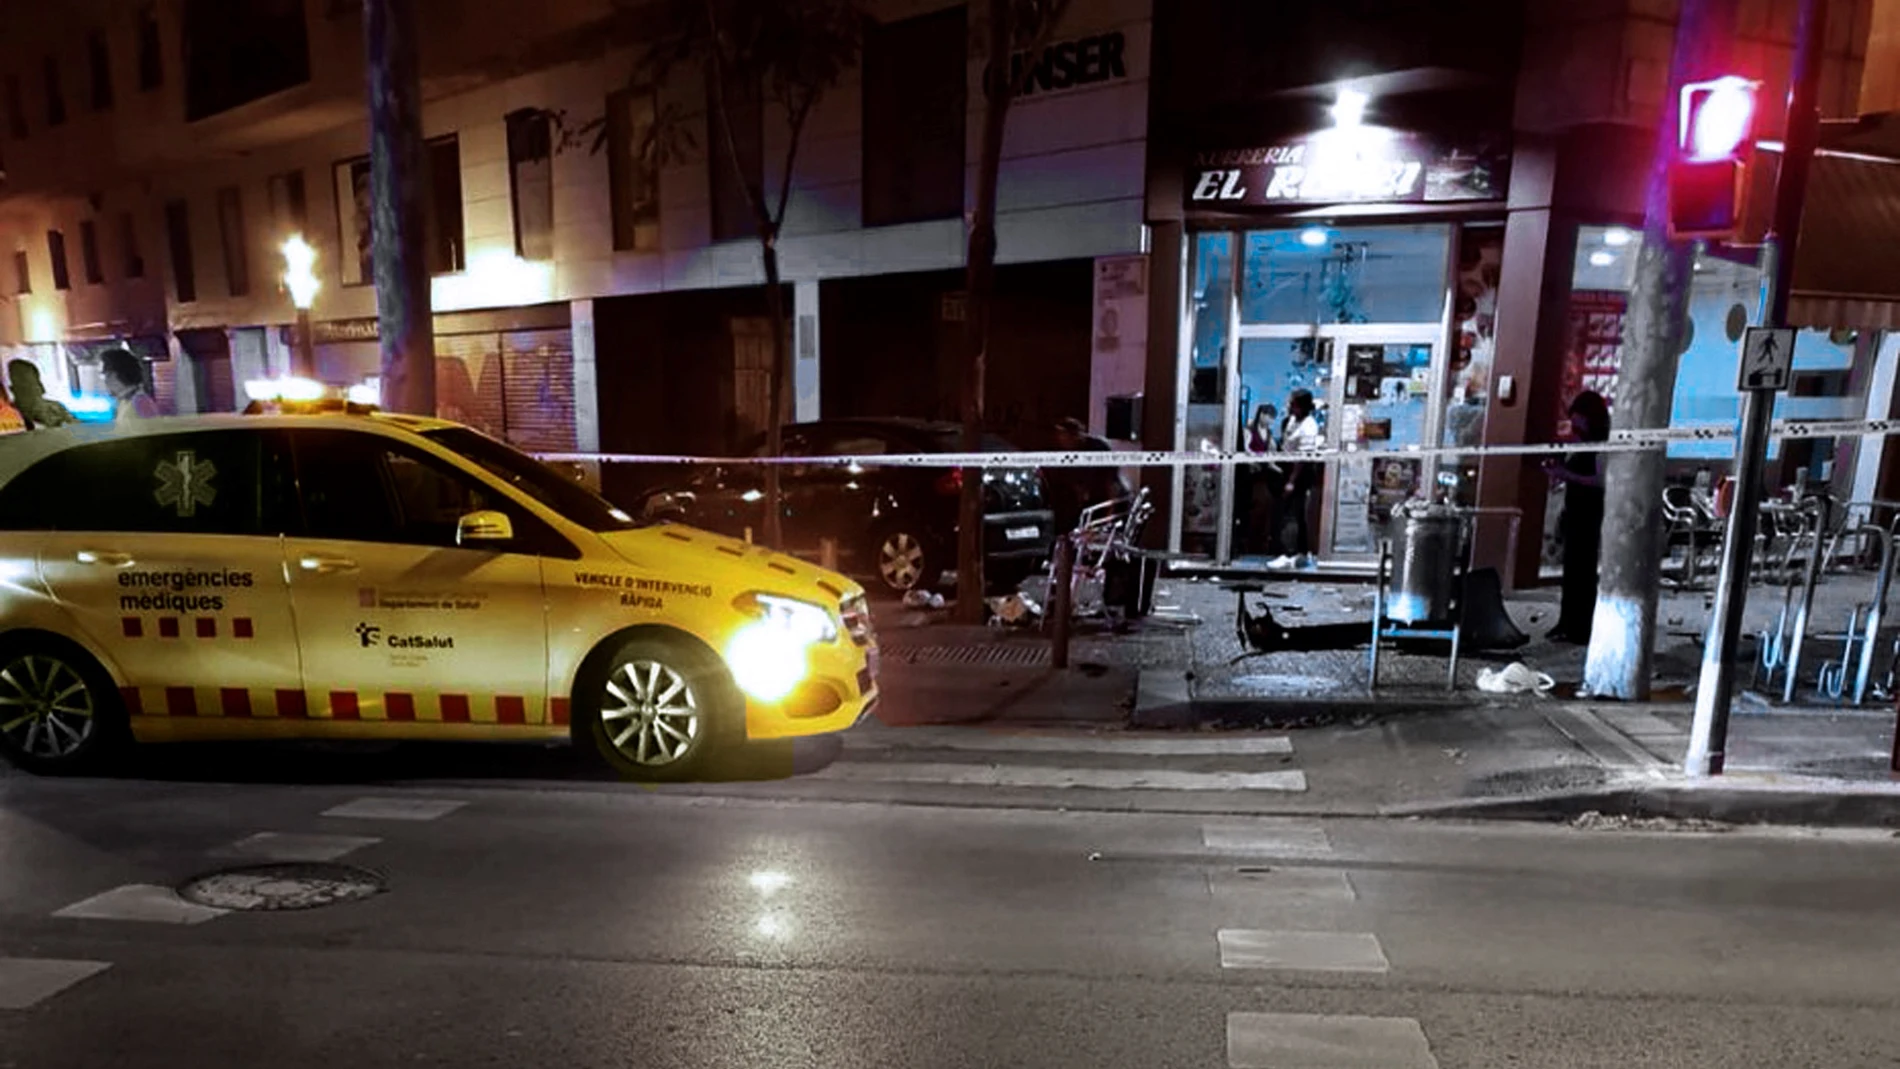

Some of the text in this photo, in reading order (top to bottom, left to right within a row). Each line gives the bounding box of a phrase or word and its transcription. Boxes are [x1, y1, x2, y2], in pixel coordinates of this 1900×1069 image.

[1193, 168, 1247, 200] EL
[118, 568, 253, 591] emergències
[574, 572, 621, 587] VEHICLE
[388, 635, 454, 648] CatSalut
